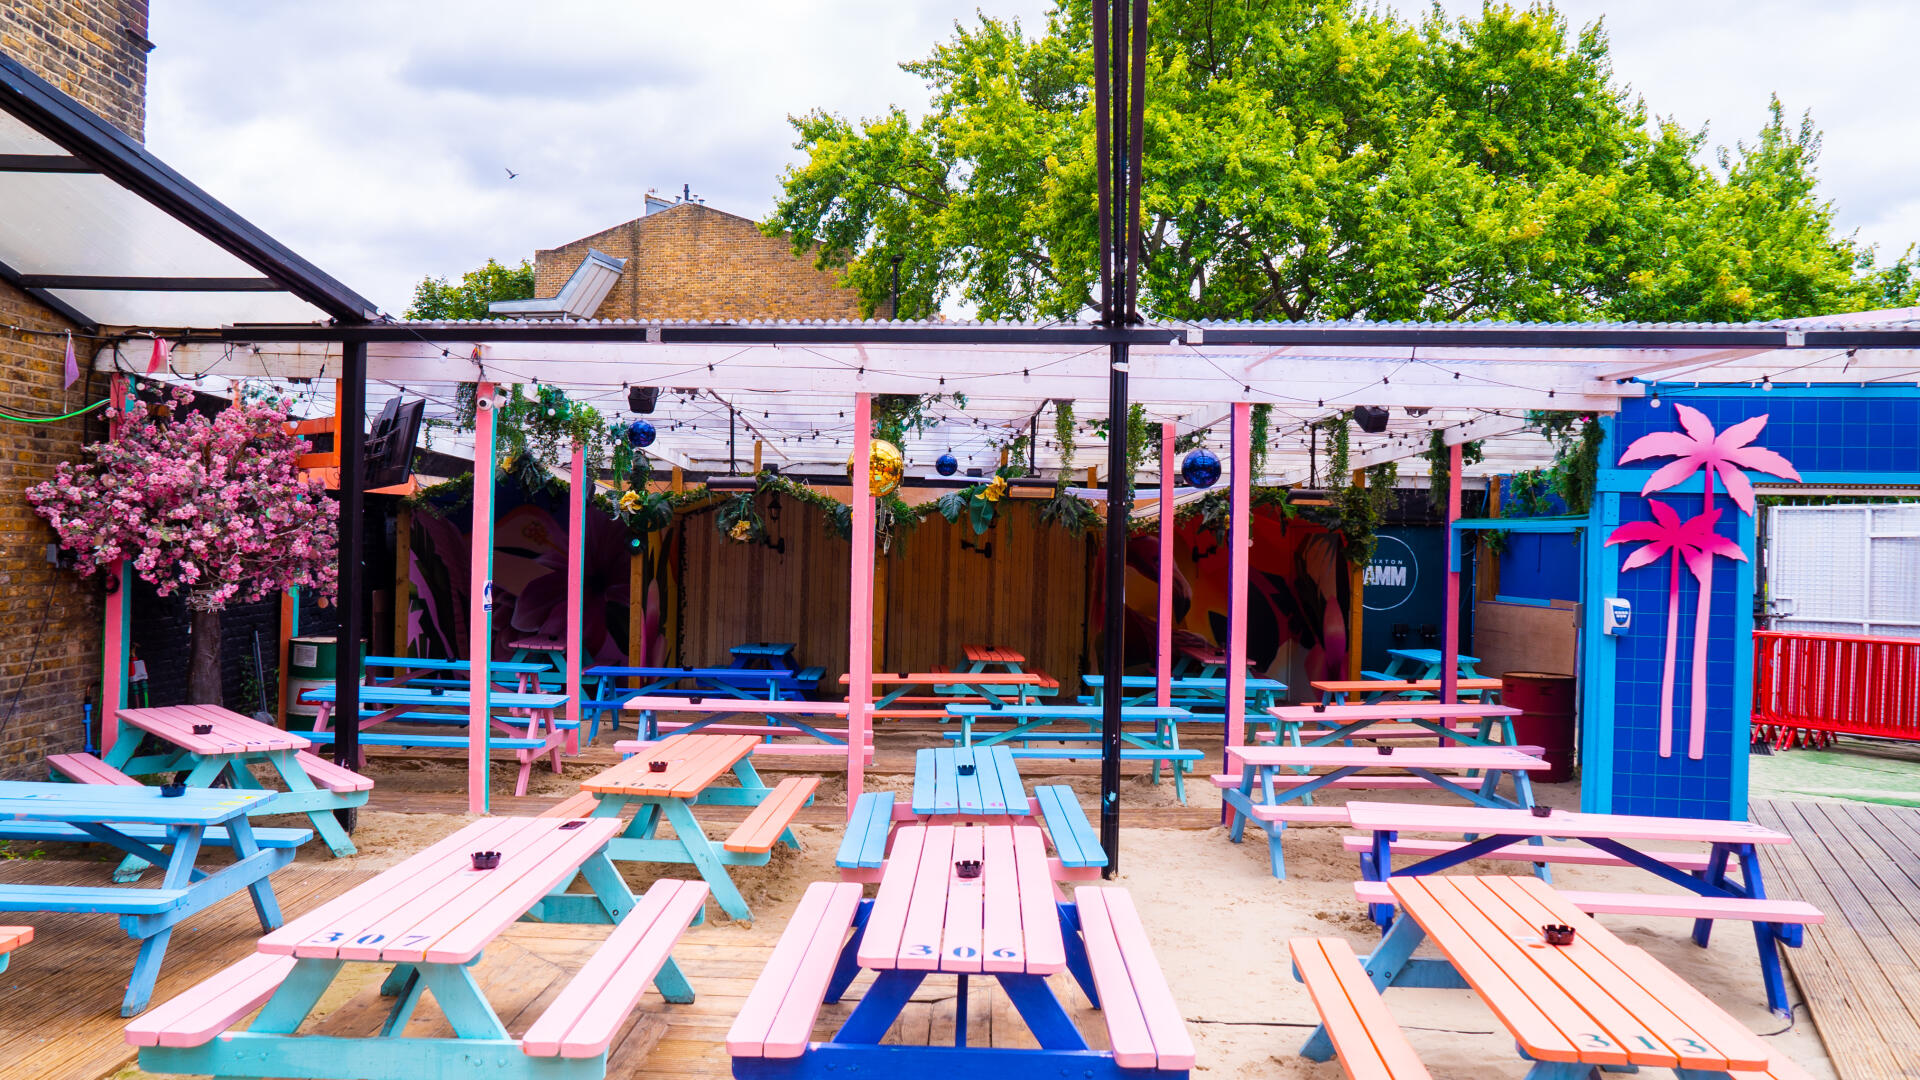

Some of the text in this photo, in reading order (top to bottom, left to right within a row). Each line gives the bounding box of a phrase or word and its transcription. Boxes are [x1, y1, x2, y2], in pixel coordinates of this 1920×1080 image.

[1362, 565, 1407, 587] AMM
[311, 931, 432, 947] 307
[907, 944, 1017, 958] 306
[1577, 1032, 1707, 1054] 313
